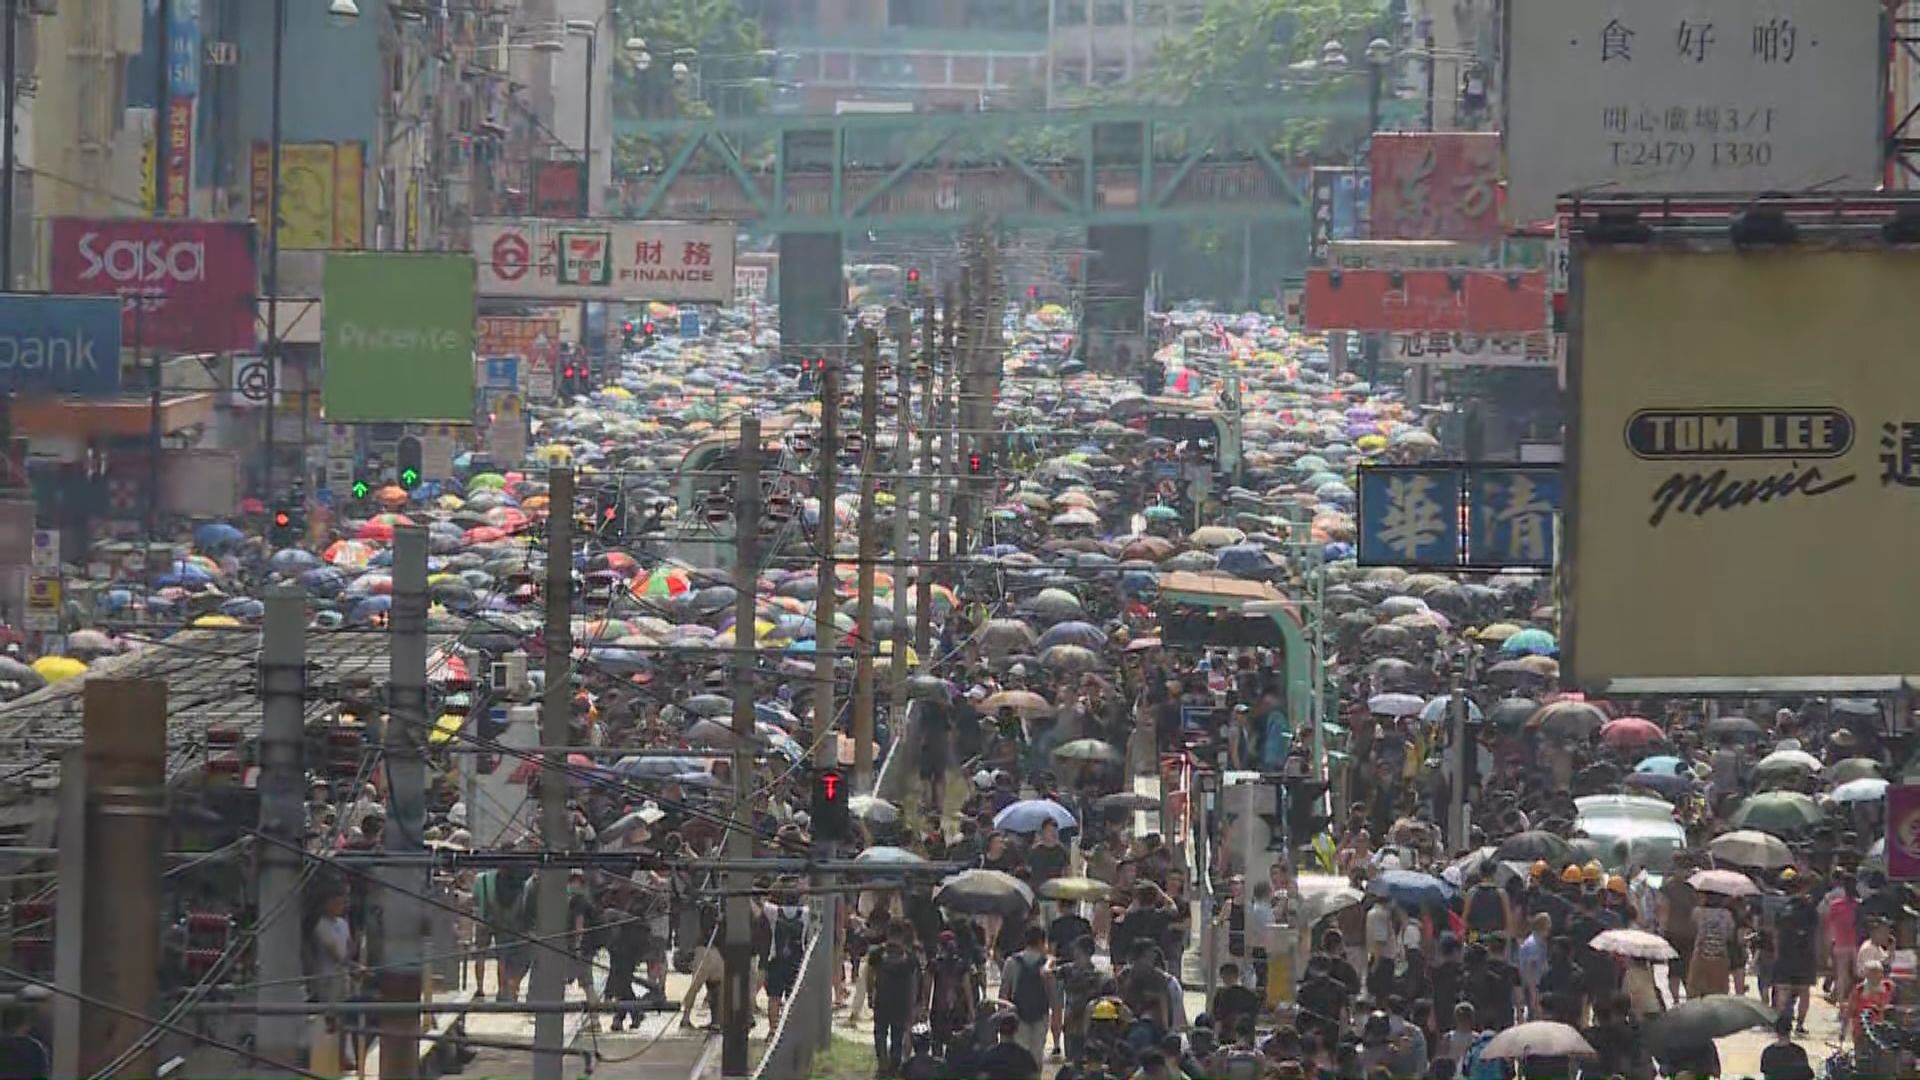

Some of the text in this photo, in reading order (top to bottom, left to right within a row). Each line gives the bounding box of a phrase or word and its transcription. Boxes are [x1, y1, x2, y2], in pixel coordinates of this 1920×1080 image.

[635, 239, 713, 265] 財務
[619, 270, 714, 281] FINANCE
[1647, 415, 1833, 451] TOM LEE
[1648, 460, 1857, 528] Music
